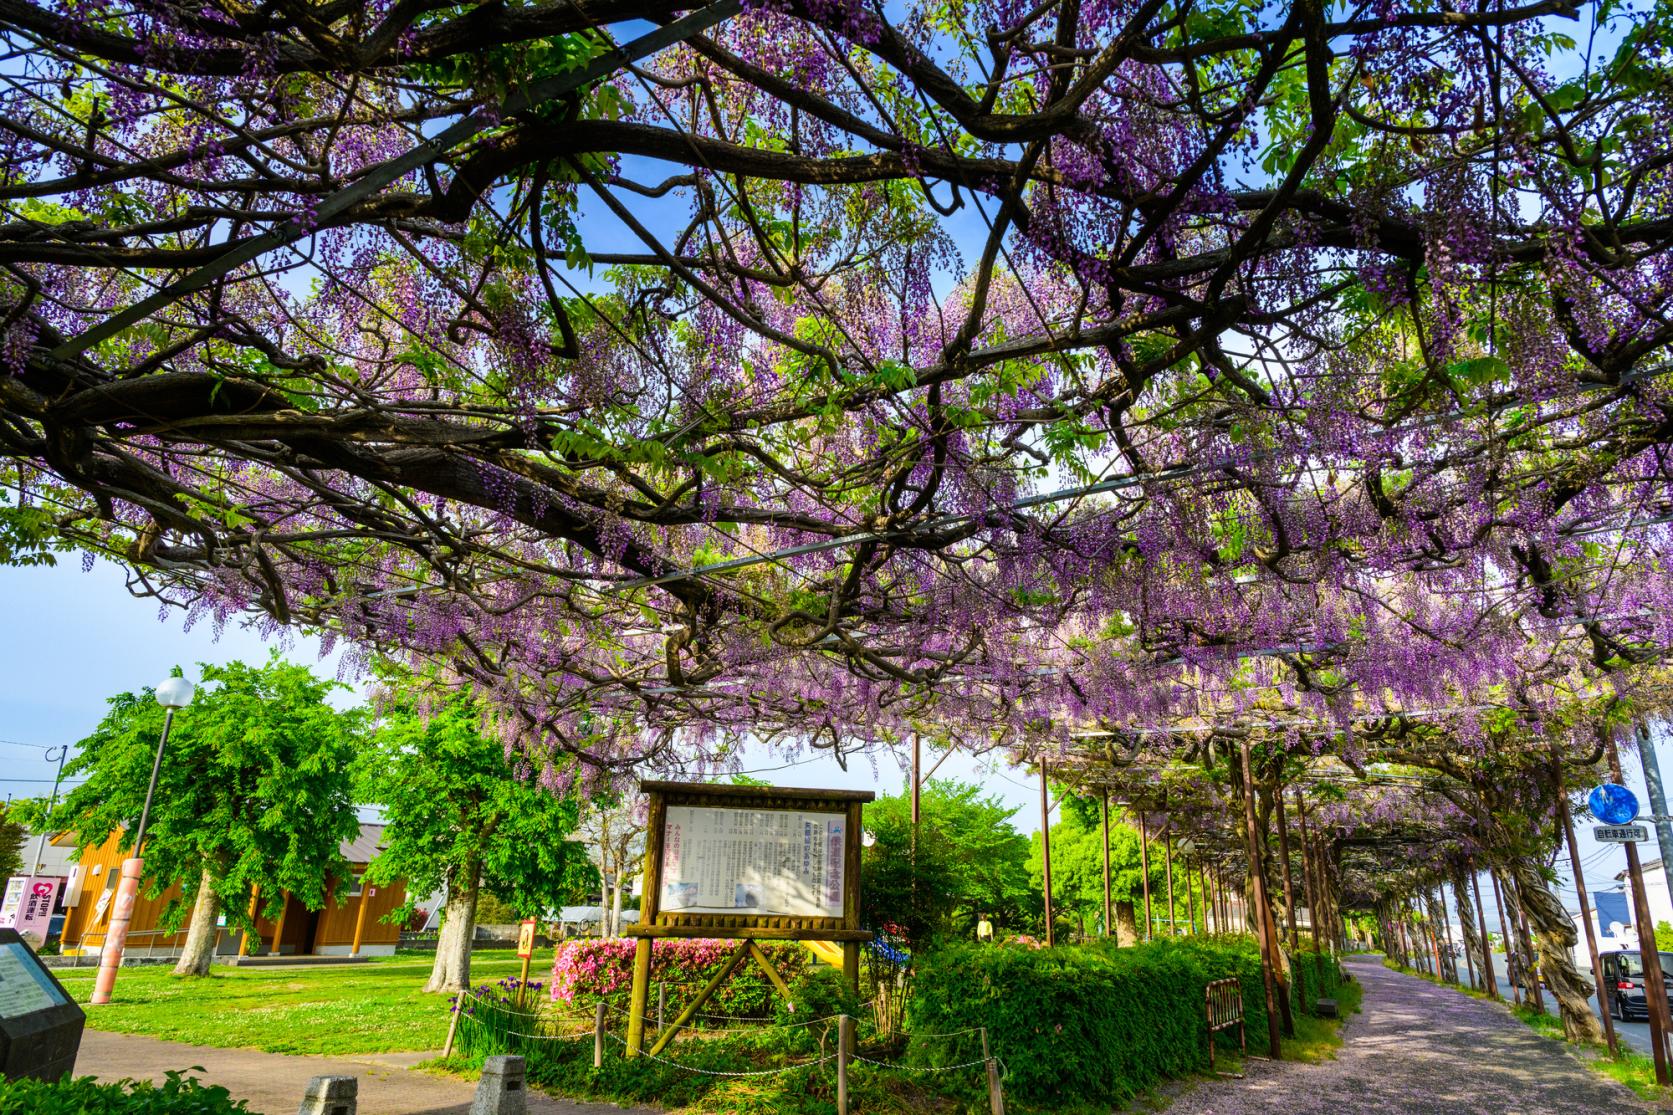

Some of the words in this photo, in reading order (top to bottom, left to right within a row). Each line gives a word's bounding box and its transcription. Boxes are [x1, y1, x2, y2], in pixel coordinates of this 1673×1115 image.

[1597, 828, 1641, 839] 自転車通行可
